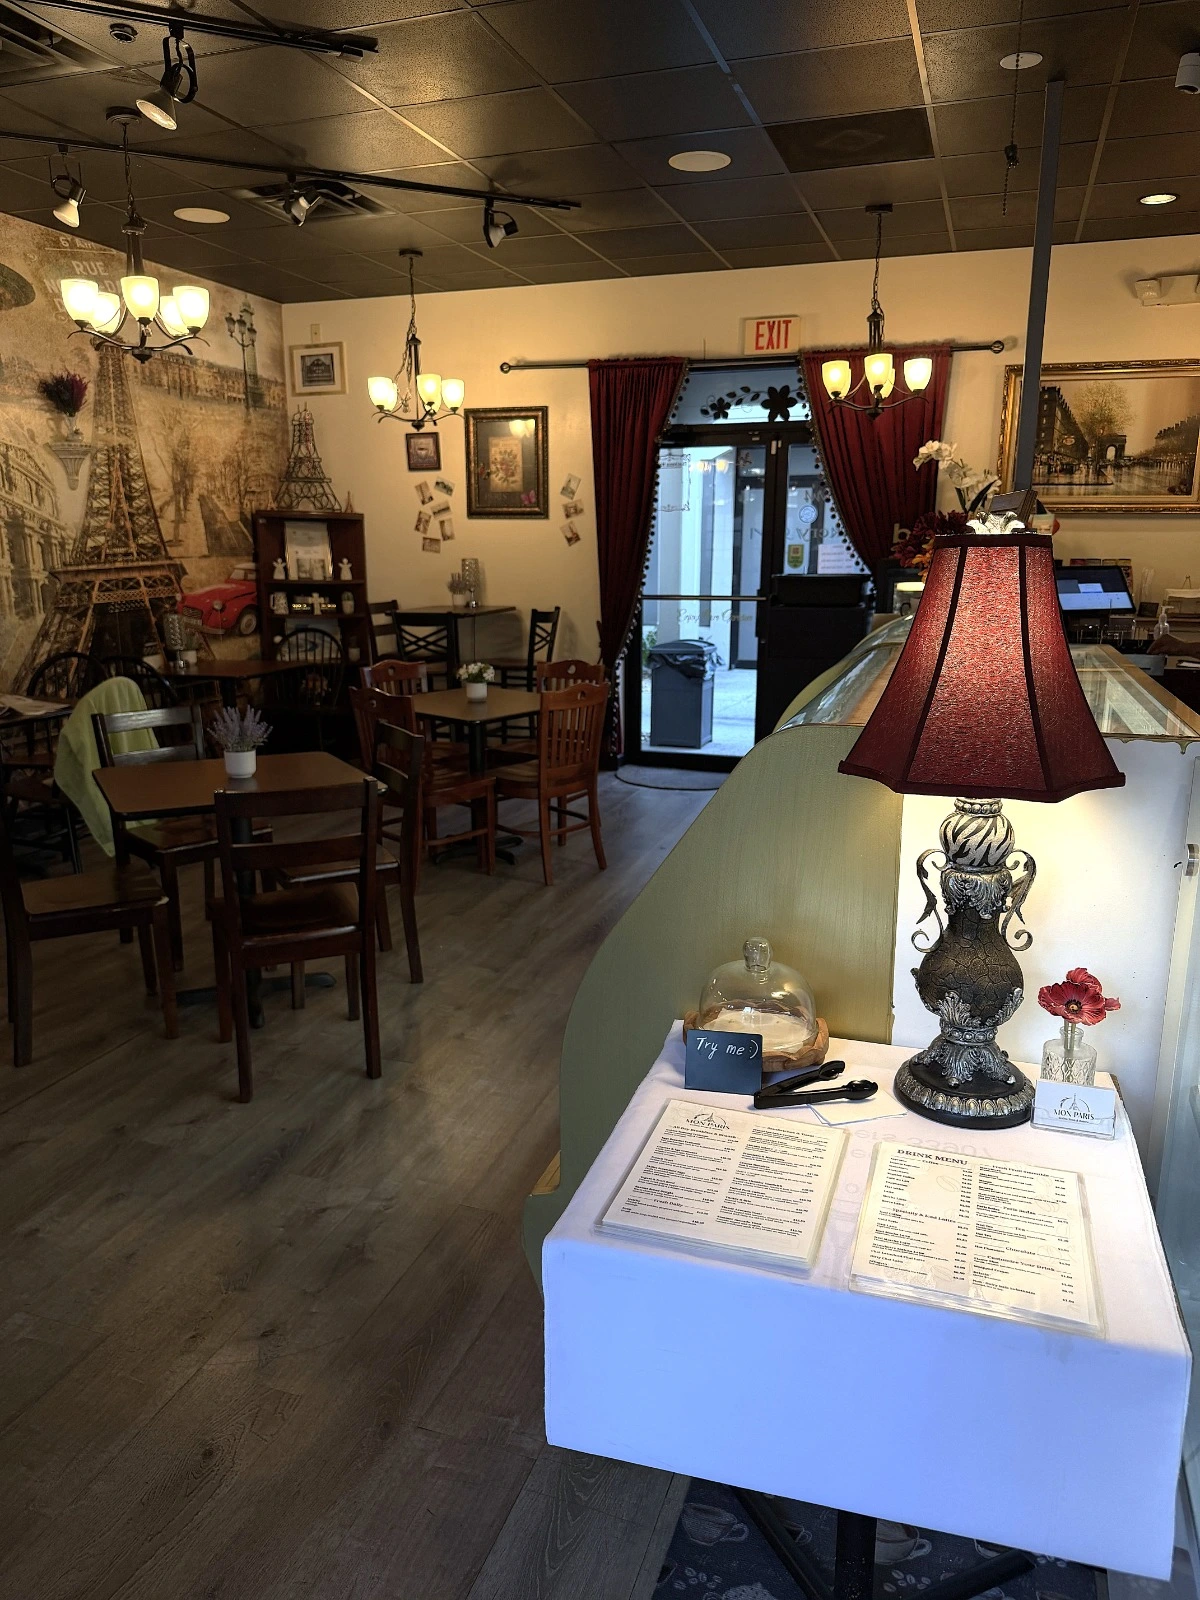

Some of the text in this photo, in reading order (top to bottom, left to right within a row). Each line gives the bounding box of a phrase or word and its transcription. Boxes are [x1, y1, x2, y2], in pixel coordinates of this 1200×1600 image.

[71, 260, 109, 276] RUE
[754, 319, 793, 351] EXIT
[696, 1036, 718, 1060] Try
[725, 1044, 746, 1056] me
[1053, 1108, 1072, 1118] MON
[1073, 1111, 1095, 1121] PARIS
[685, 1118, 705, 1126] MON
[707, 1121, 730, 1130] PARIS
[896, 1149, 968, 1166] DRINK MENU
